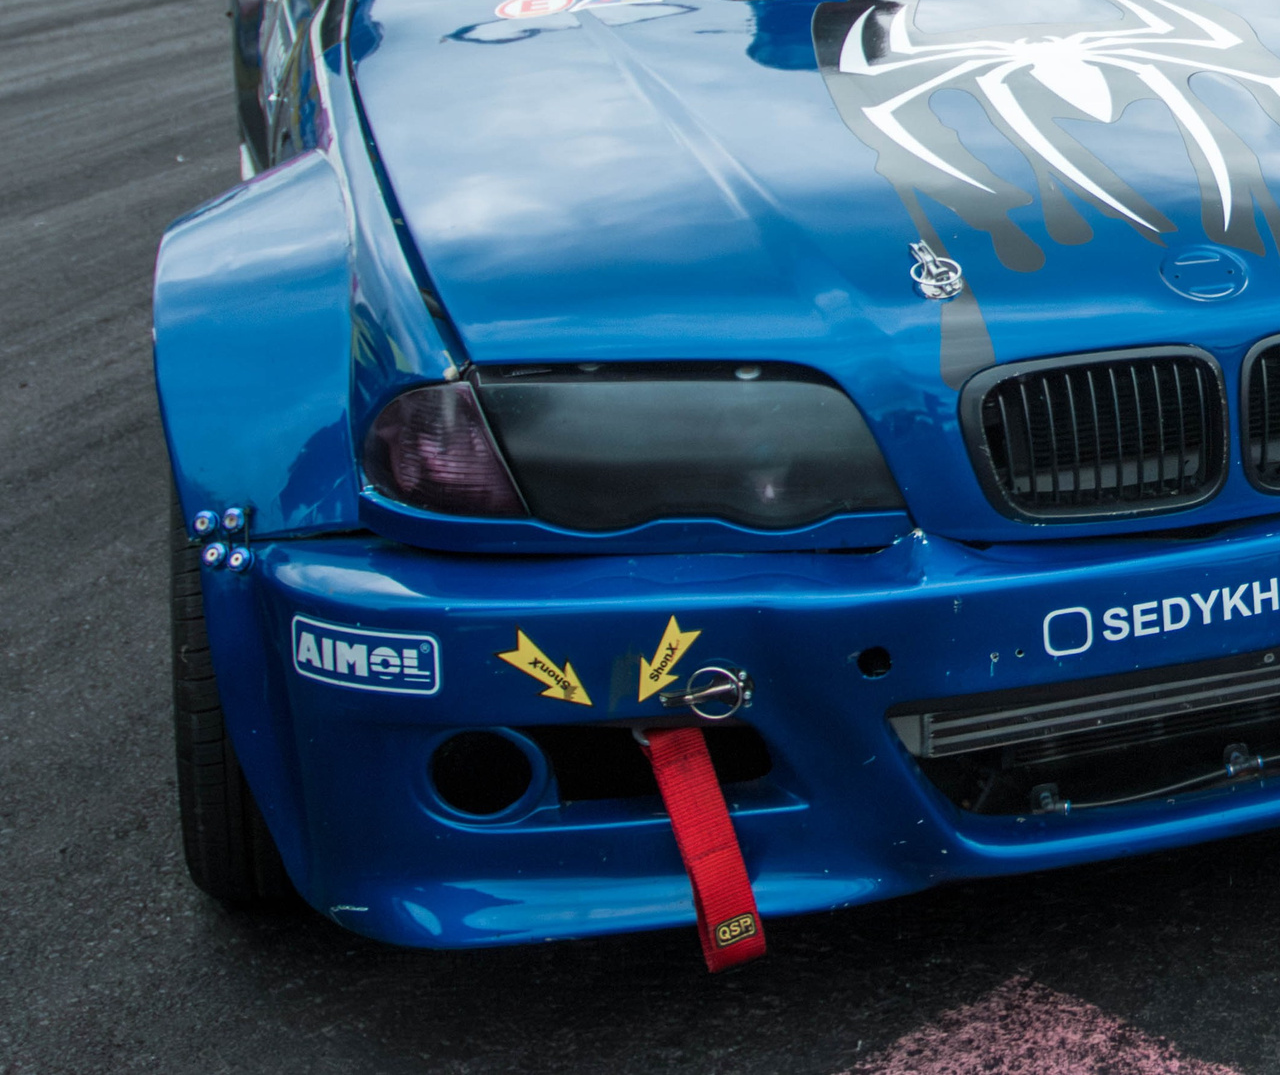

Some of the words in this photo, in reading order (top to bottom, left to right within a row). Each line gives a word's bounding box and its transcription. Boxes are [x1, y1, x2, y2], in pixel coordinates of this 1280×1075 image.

[298, 632, 430, 682] AIMOL
[528, 657, 571, 690] ShonX
[650, 642, 677, 682] ShonX
